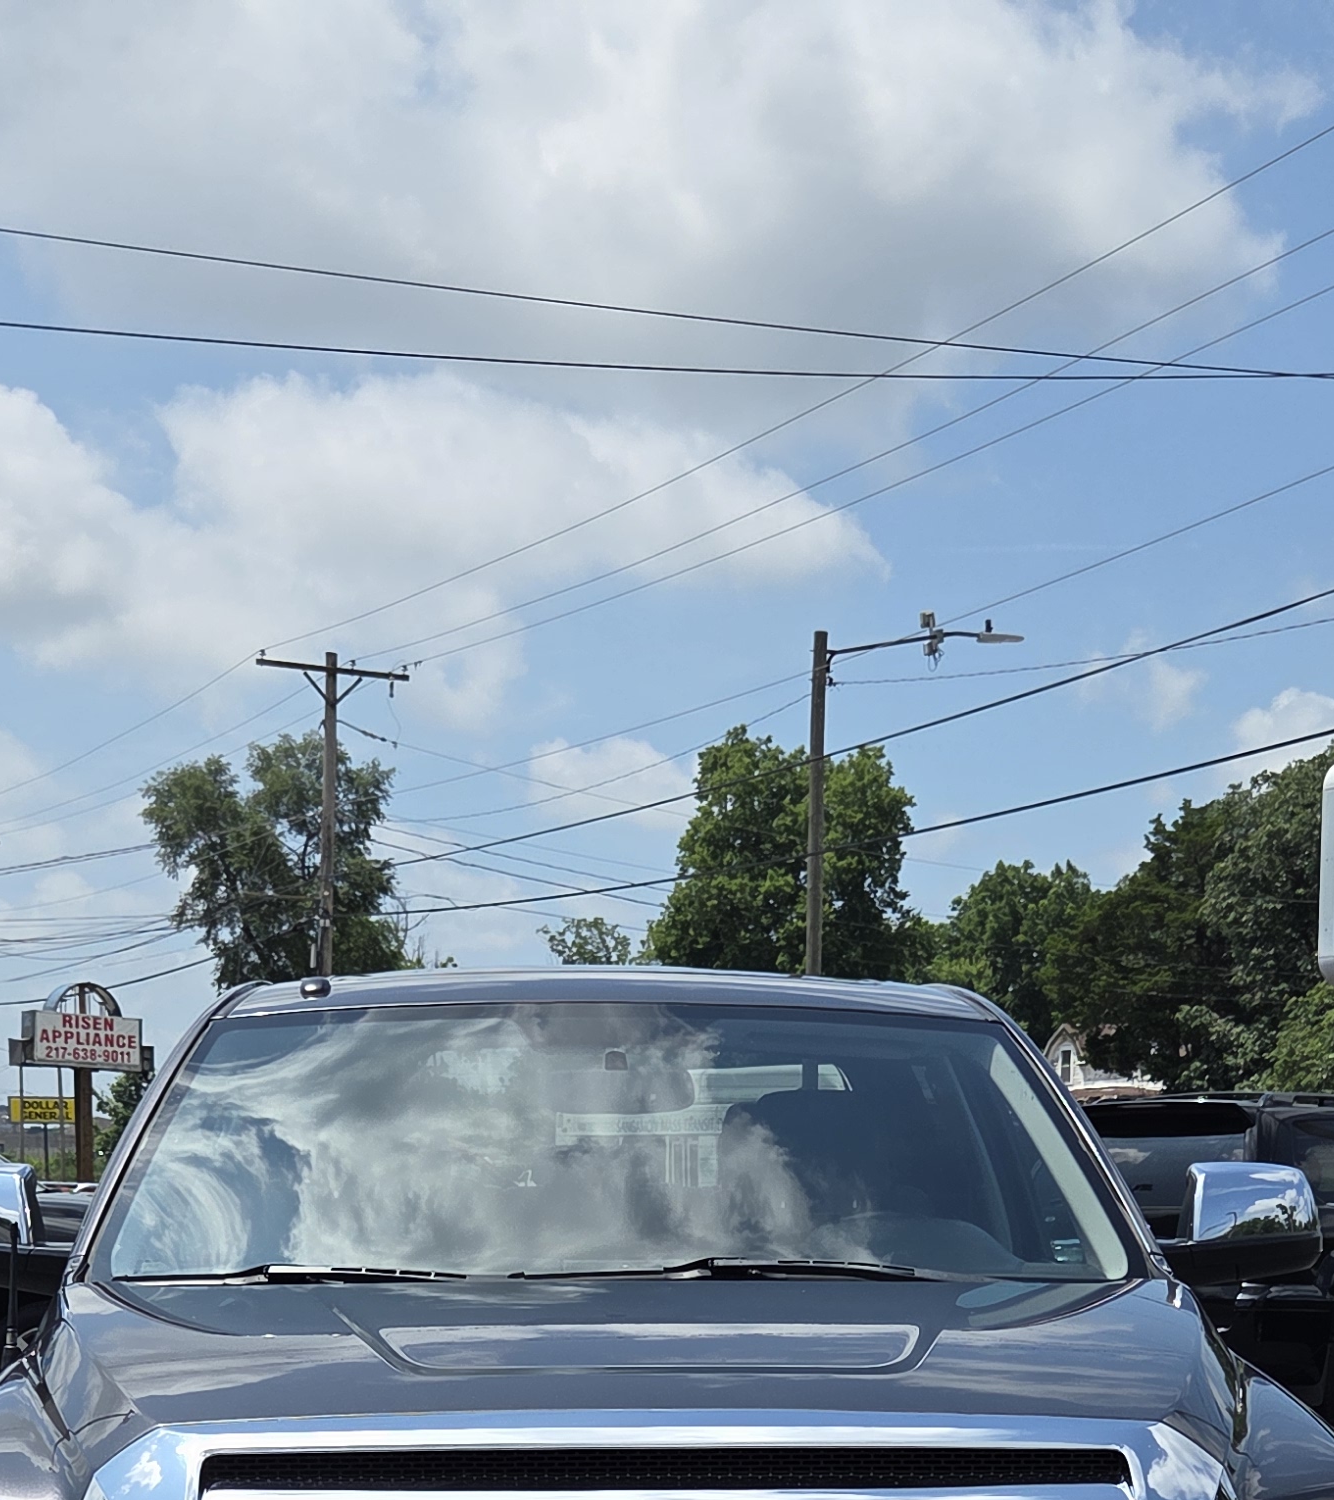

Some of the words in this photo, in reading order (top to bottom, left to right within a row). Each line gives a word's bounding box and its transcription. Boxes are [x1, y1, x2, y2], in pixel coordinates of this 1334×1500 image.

[62, 1014, 114, 1032] RISEN
[39, 1029, 137, 1049] APPLIANCE
[45, 1045, 132, 1063] 217-638-9011
[23, 1100, 69, 1110] DOLLAR
[23, 1111, 73, 1120] GENERL
